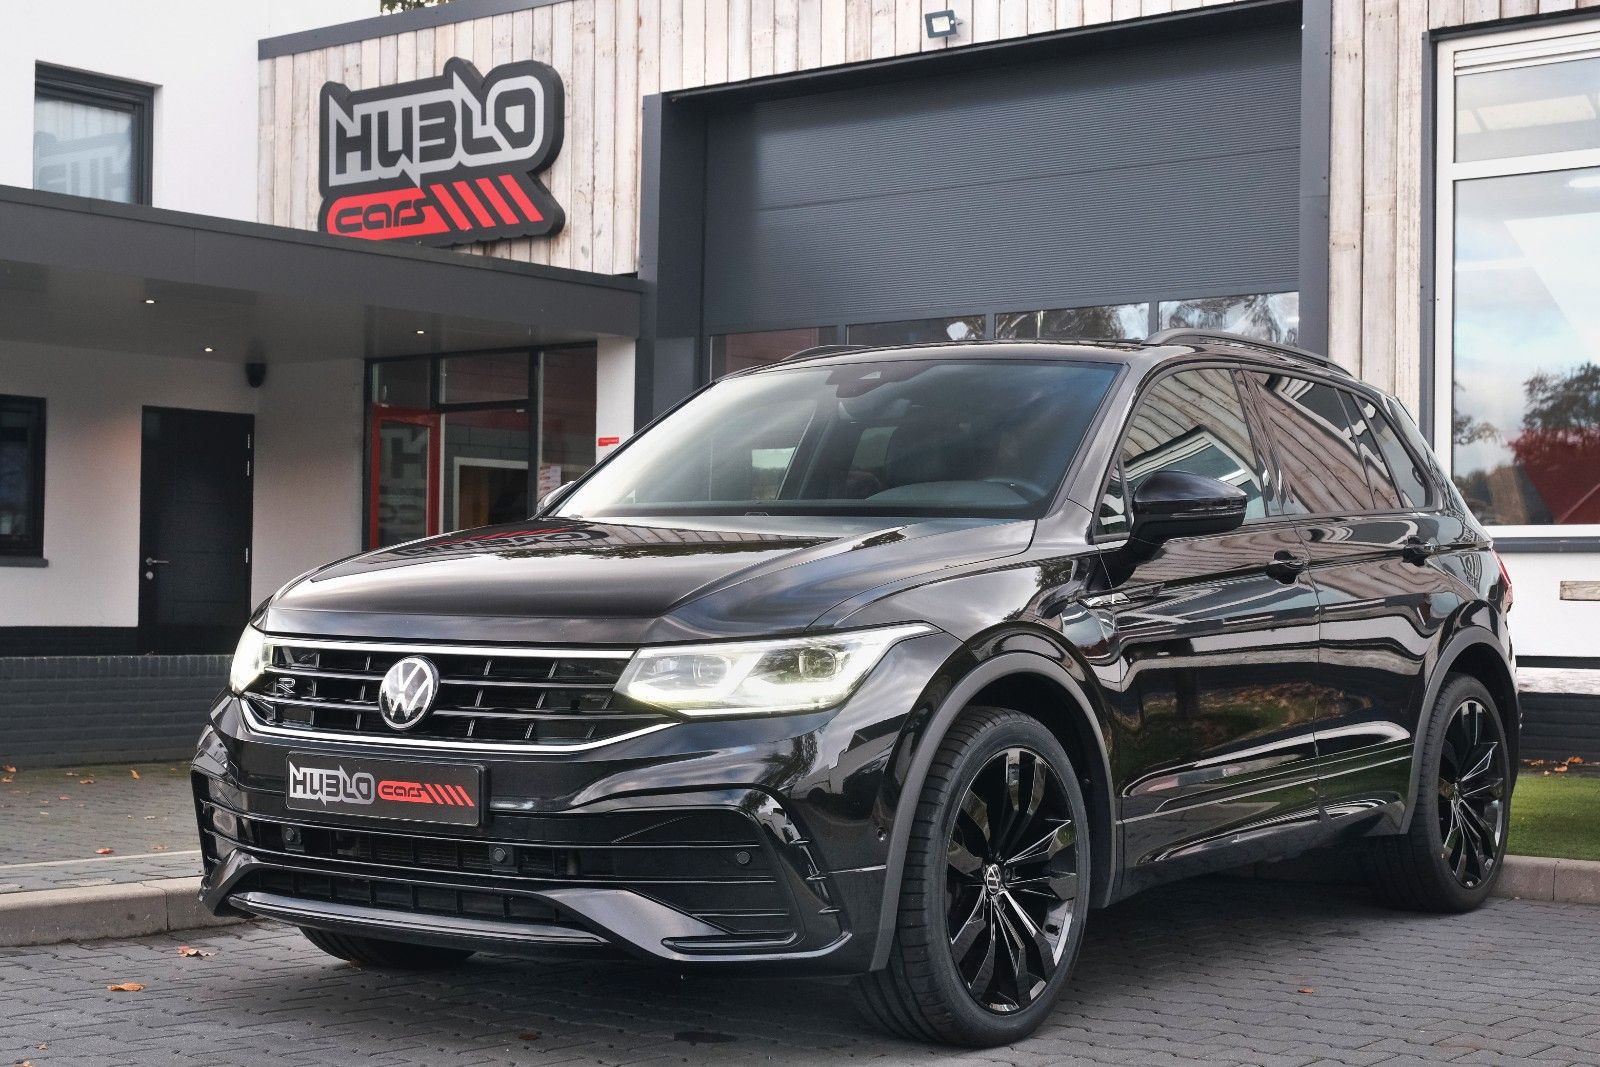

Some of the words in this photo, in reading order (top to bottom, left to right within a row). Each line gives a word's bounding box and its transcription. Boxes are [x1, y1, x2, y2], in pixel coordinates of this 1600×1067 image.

[329, 71, 545, 188] HUBLO
[334, 198, 427, 234] cars
[289, 761, 376, 806] HUBLO
